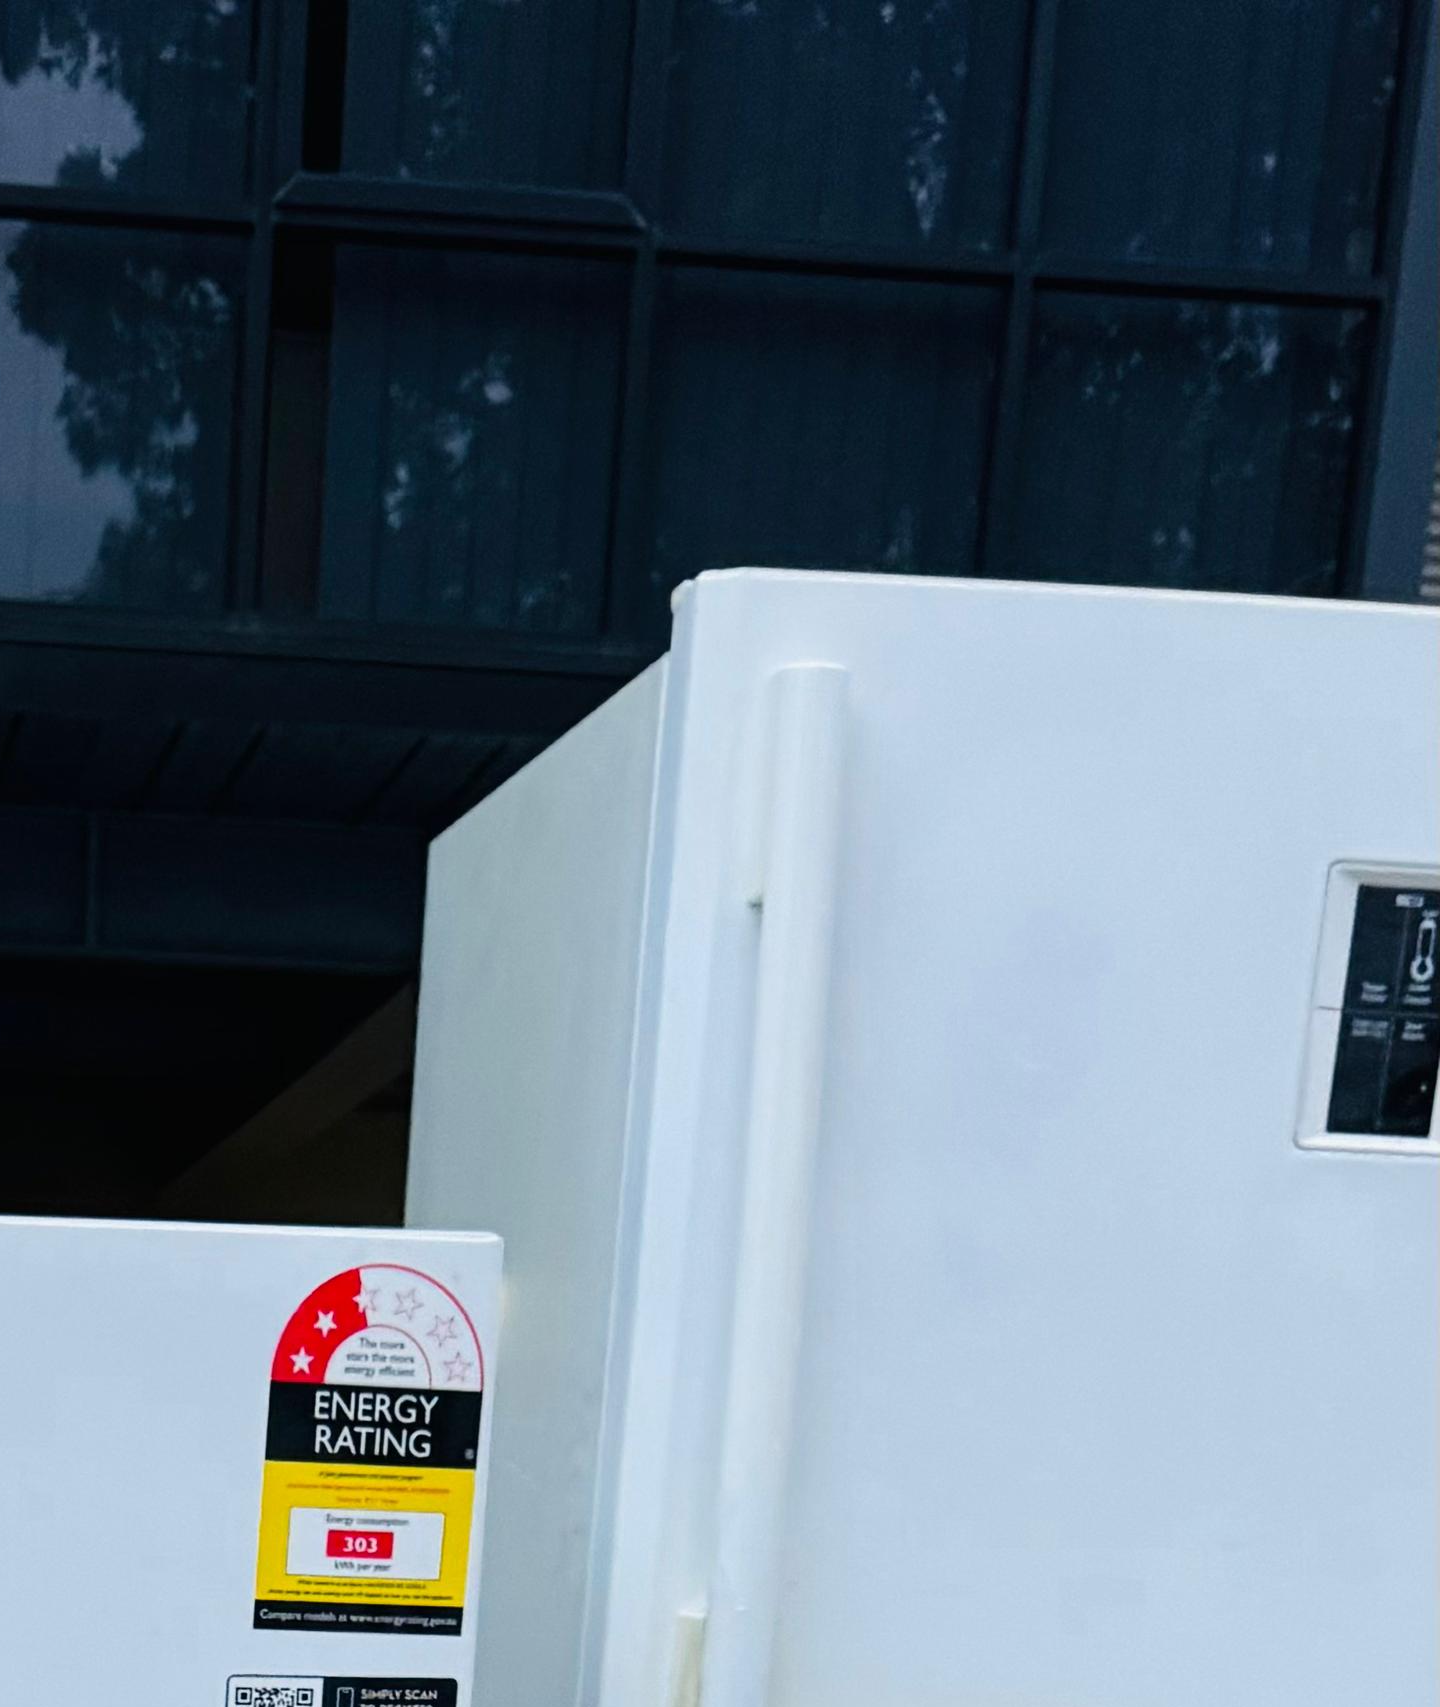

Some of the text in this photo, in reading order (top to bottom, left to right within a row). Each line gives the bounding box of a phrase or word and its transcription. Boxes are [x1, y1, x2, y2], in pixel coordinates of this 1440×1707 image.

[314, 1390, 440, 1425] ENERGY
[314, 1424, 433, 1459] RATING
[343, 1536, 379, 1554] 303
[260, 1608, 302, 1622] Compare
[360, 1688, 438, 1700] SIMPLY SCAN
